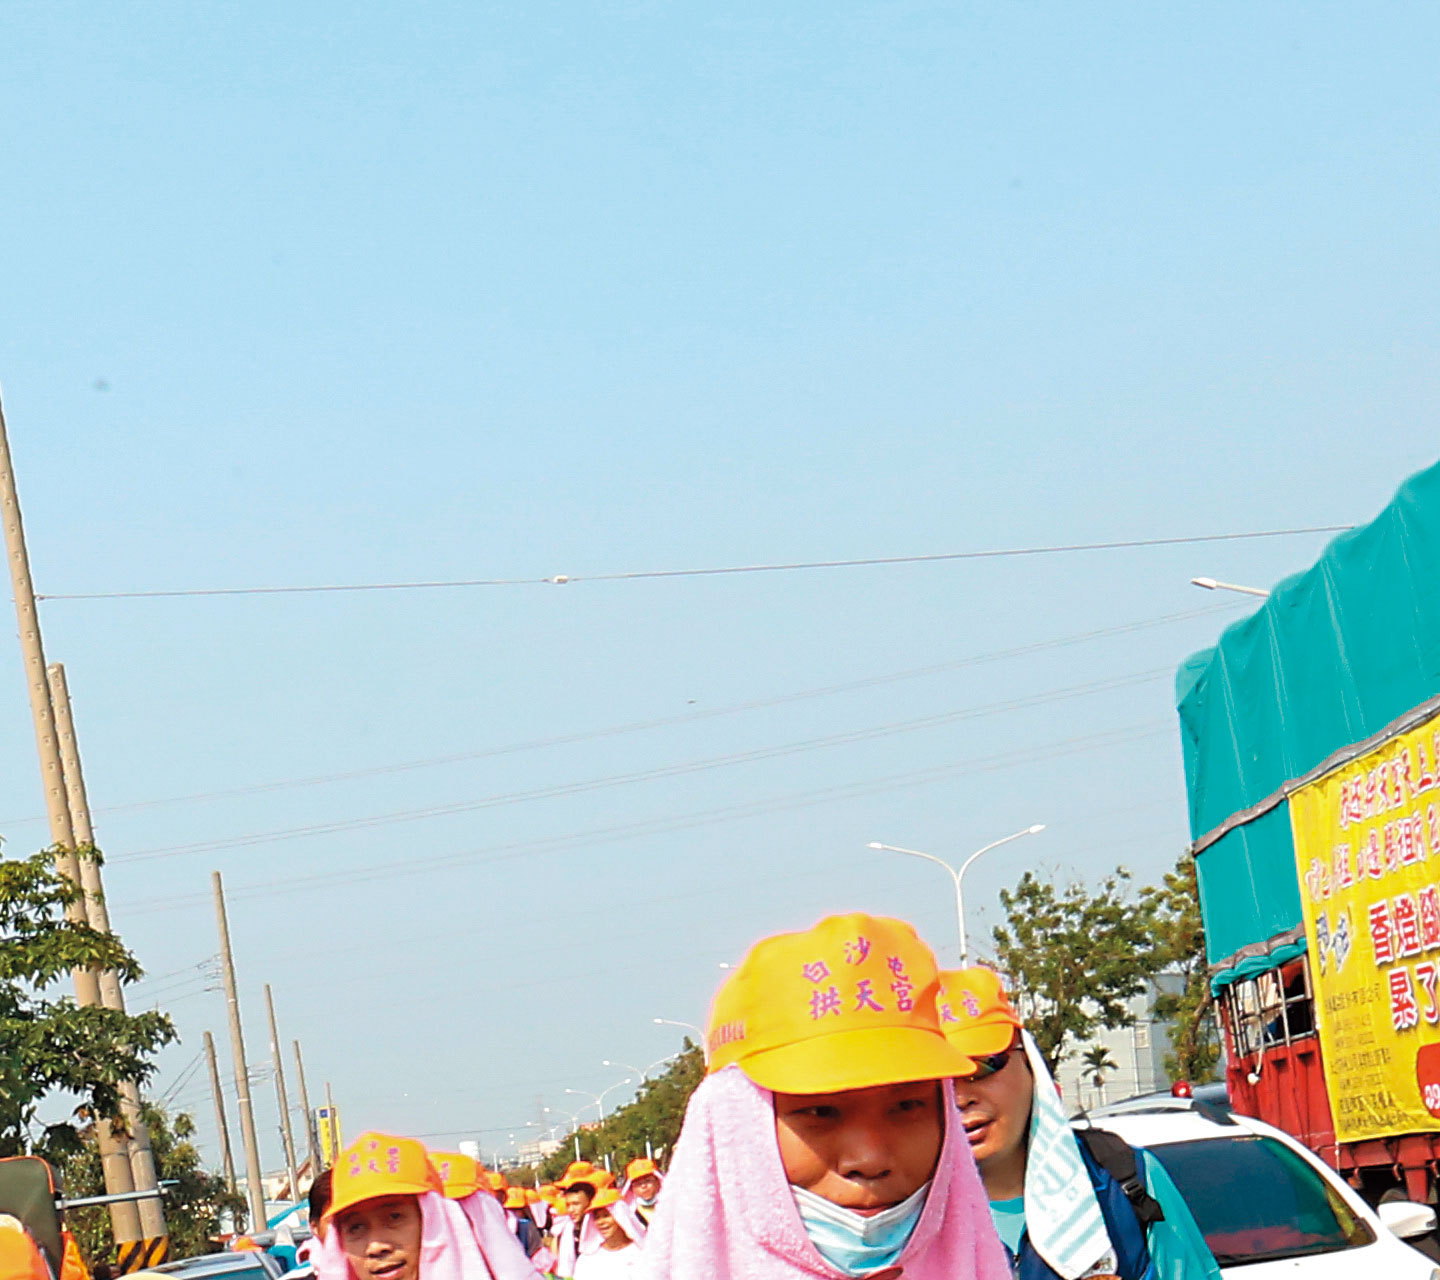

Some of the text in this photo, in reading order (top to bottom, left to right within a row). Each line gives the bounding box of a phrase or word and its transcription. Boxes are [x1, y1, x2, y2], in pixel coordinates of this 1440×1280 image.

[802, 936, 910, 985] 白沙屯
[808, 979, 915, 1021] 拱天宮
